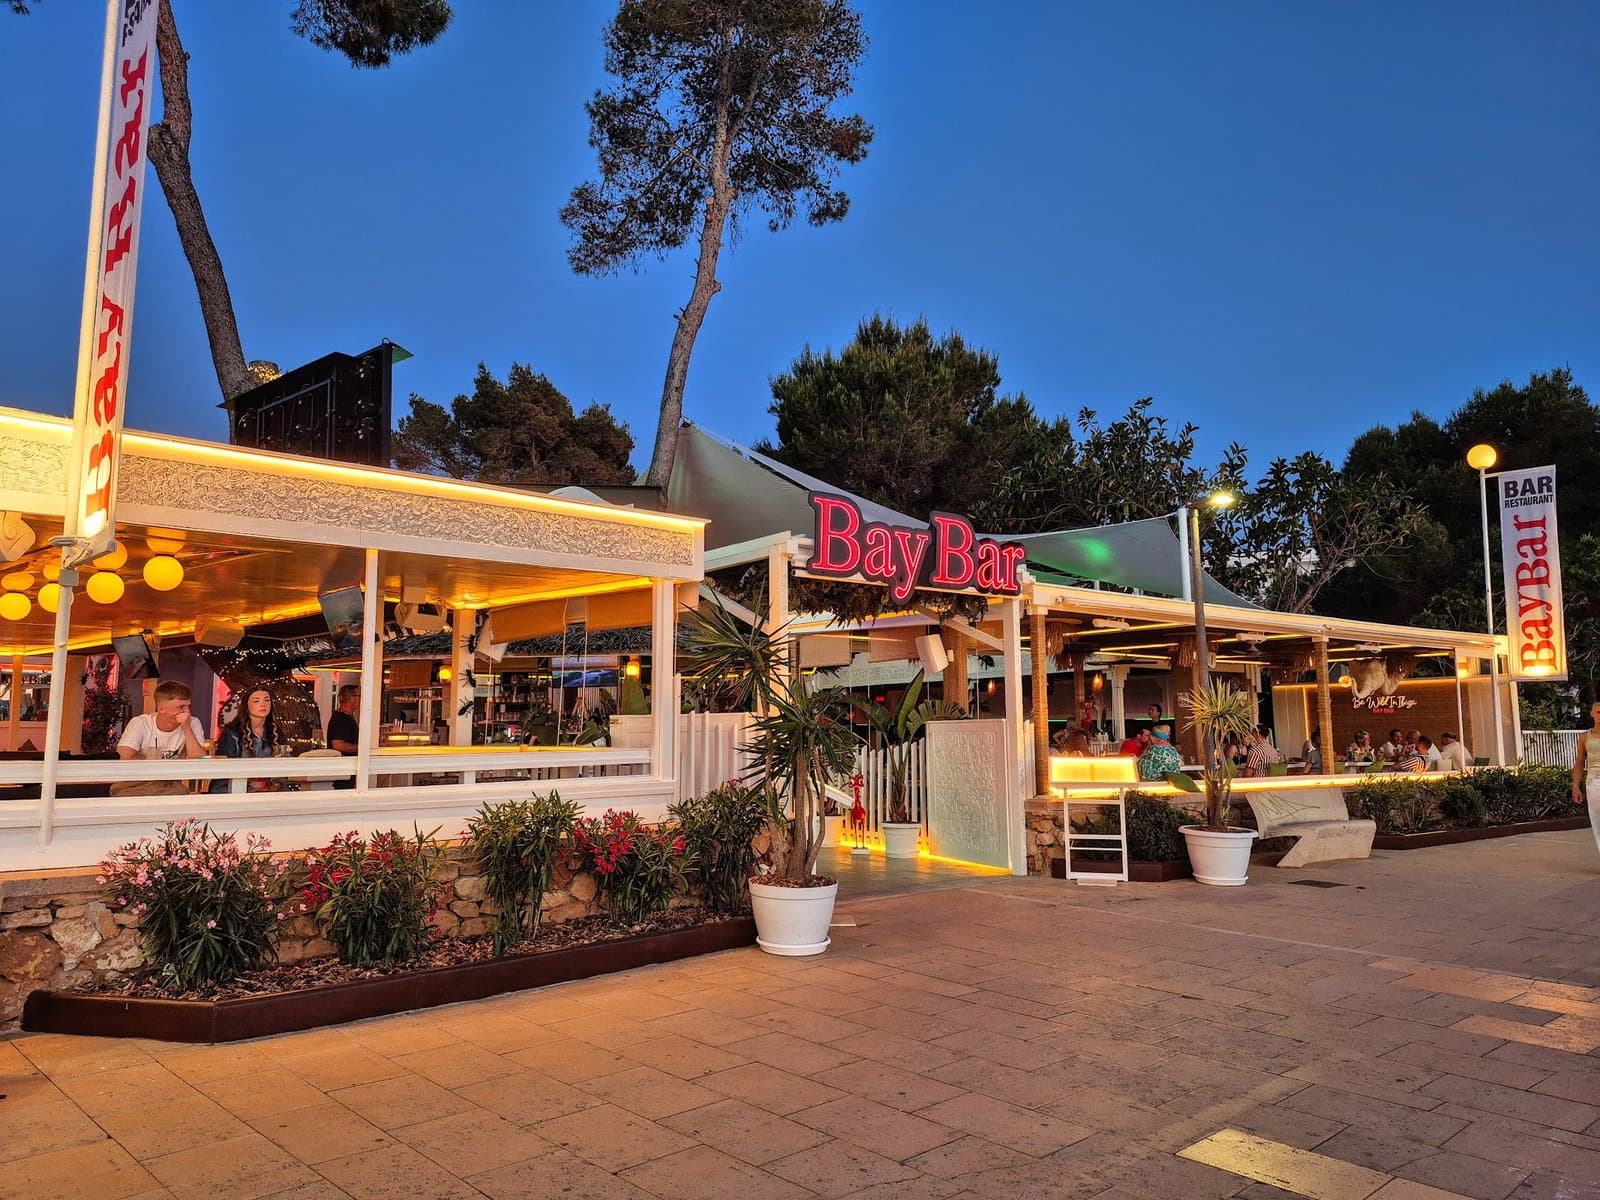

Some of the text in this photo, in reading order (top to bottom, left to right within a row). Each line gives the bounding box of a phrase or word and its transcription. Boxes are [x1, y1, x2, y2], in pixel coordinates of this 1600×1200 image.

[1504, 475, 1553, 499] BAR
[1504, 494, 1554, 509] RESTAURANT
[1352, 696, 1366, 709] Be
